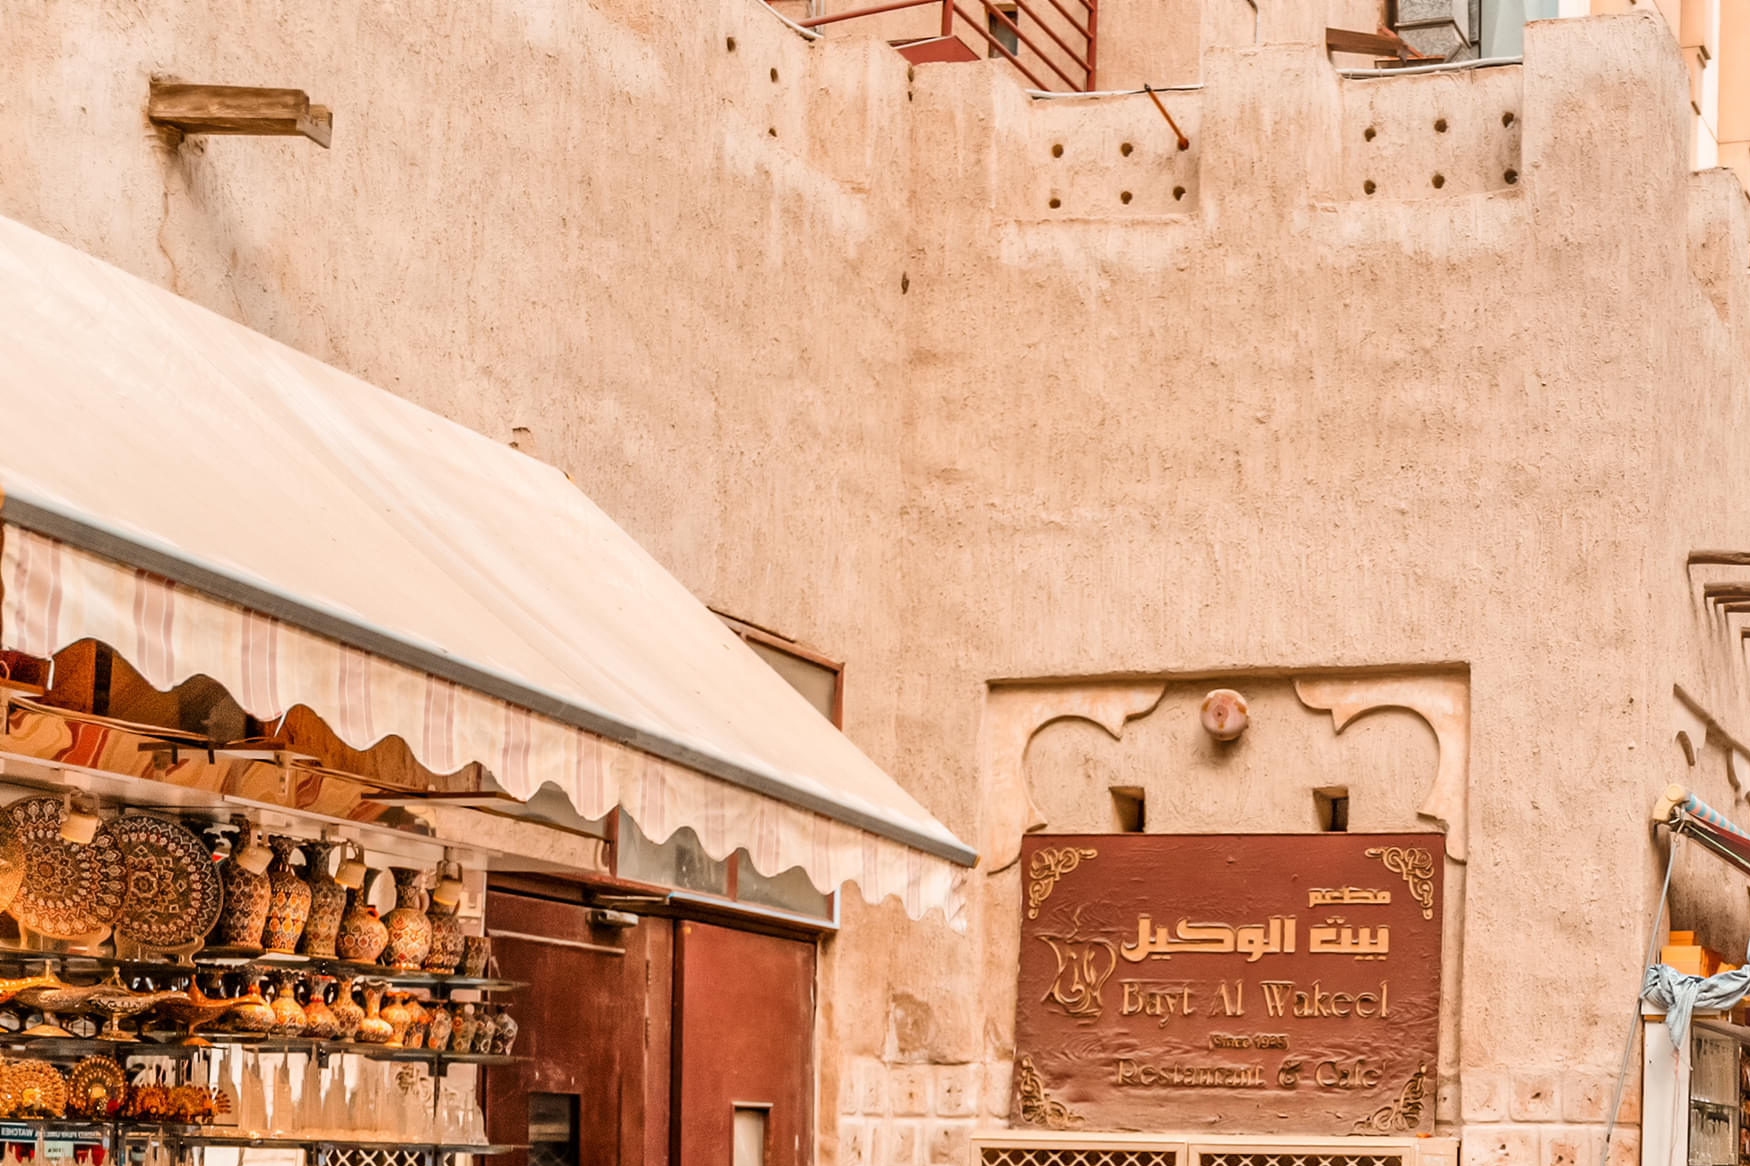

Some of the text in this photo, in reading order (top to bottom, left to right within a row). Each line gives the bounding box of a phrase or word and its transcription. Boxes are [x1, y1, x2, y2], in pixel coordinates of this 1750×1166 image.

[1308, 887, 1391, 908] مطعم
[1121, 914, 1390, 962] بيت الوكيل
[1121, 980, 1389, 1028] Bayt Al Wakeel
[1211, 1034, 1250, 1049] Since
[1115, 1057, 1266, 1089] Restaurant
[1277, 1057, 1301, 1088] &
